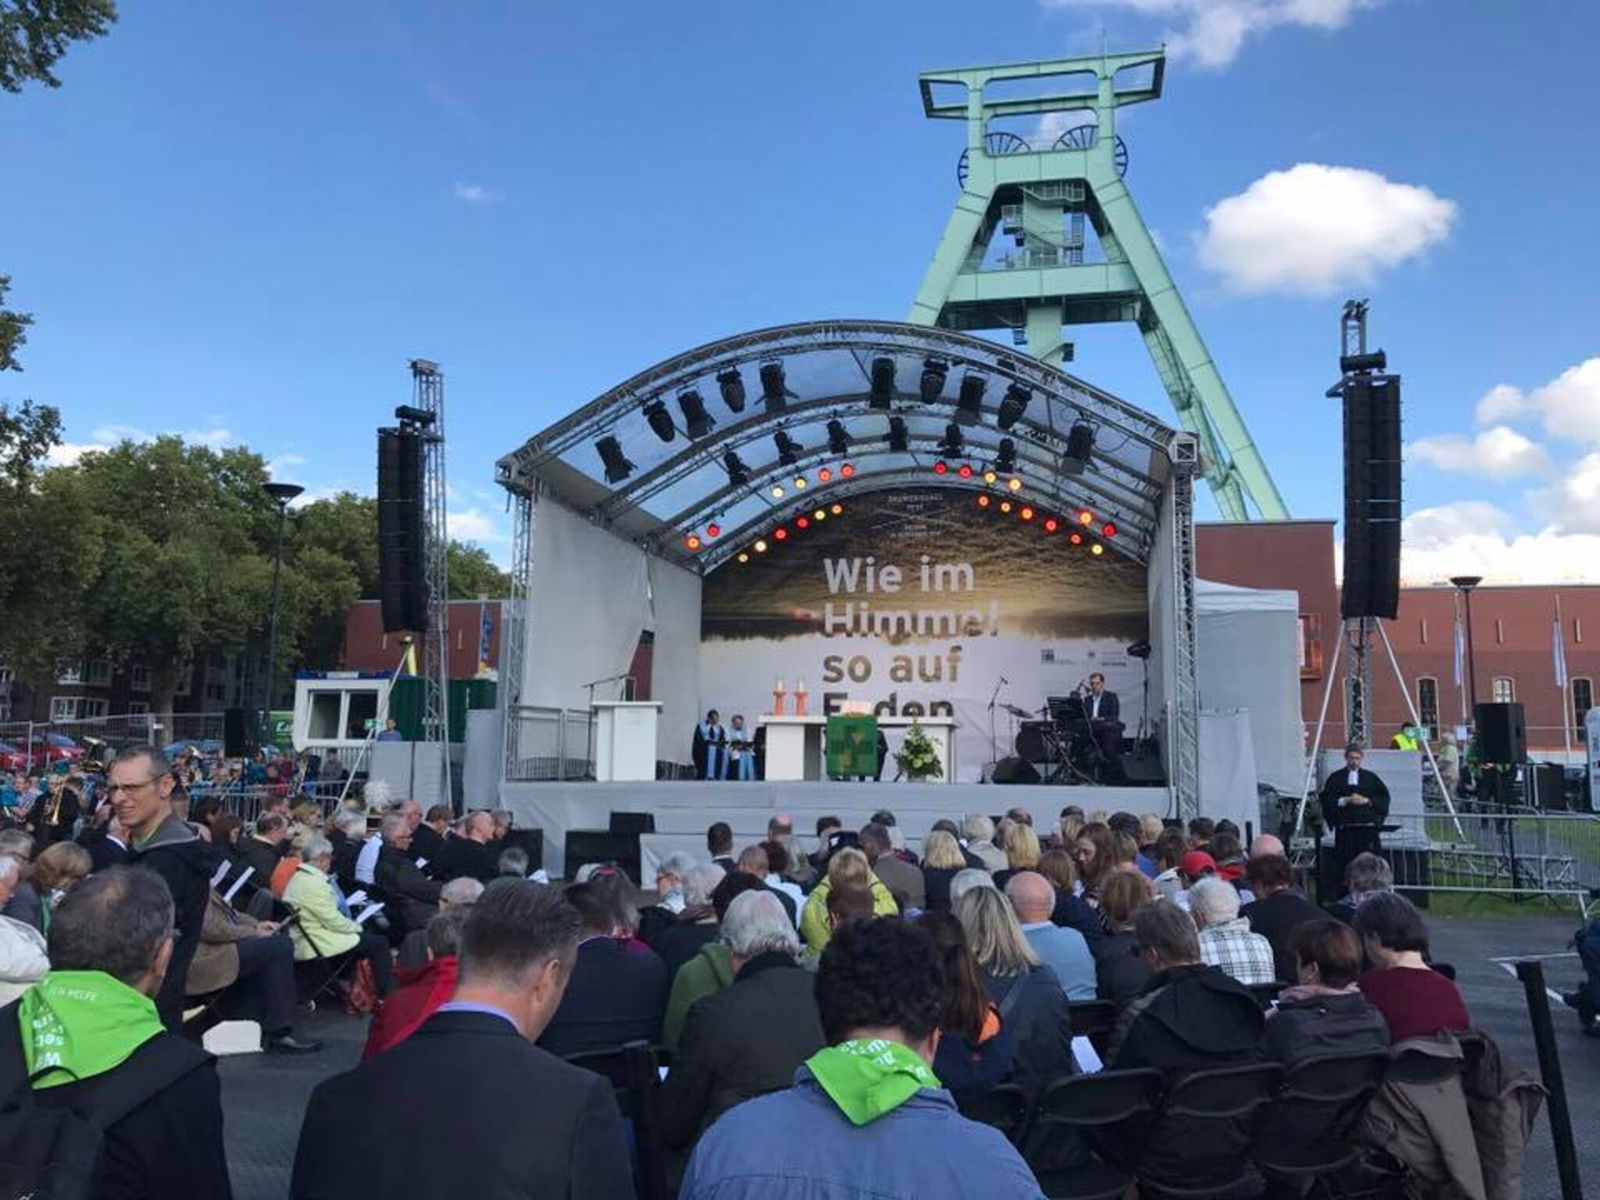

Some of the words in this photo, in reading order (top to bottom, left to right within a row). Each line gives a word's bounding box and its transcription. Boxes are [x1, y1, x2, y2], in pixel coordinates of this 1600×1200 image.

[823, 556, 902, 593] Wie
[920, 555, 975, 592] im
[824, 600, 998, 637] Himmel
[823, 655, 872, 683] so
[889, 645, 962, 683] auf
[823, 692, 954, 717] Eden
